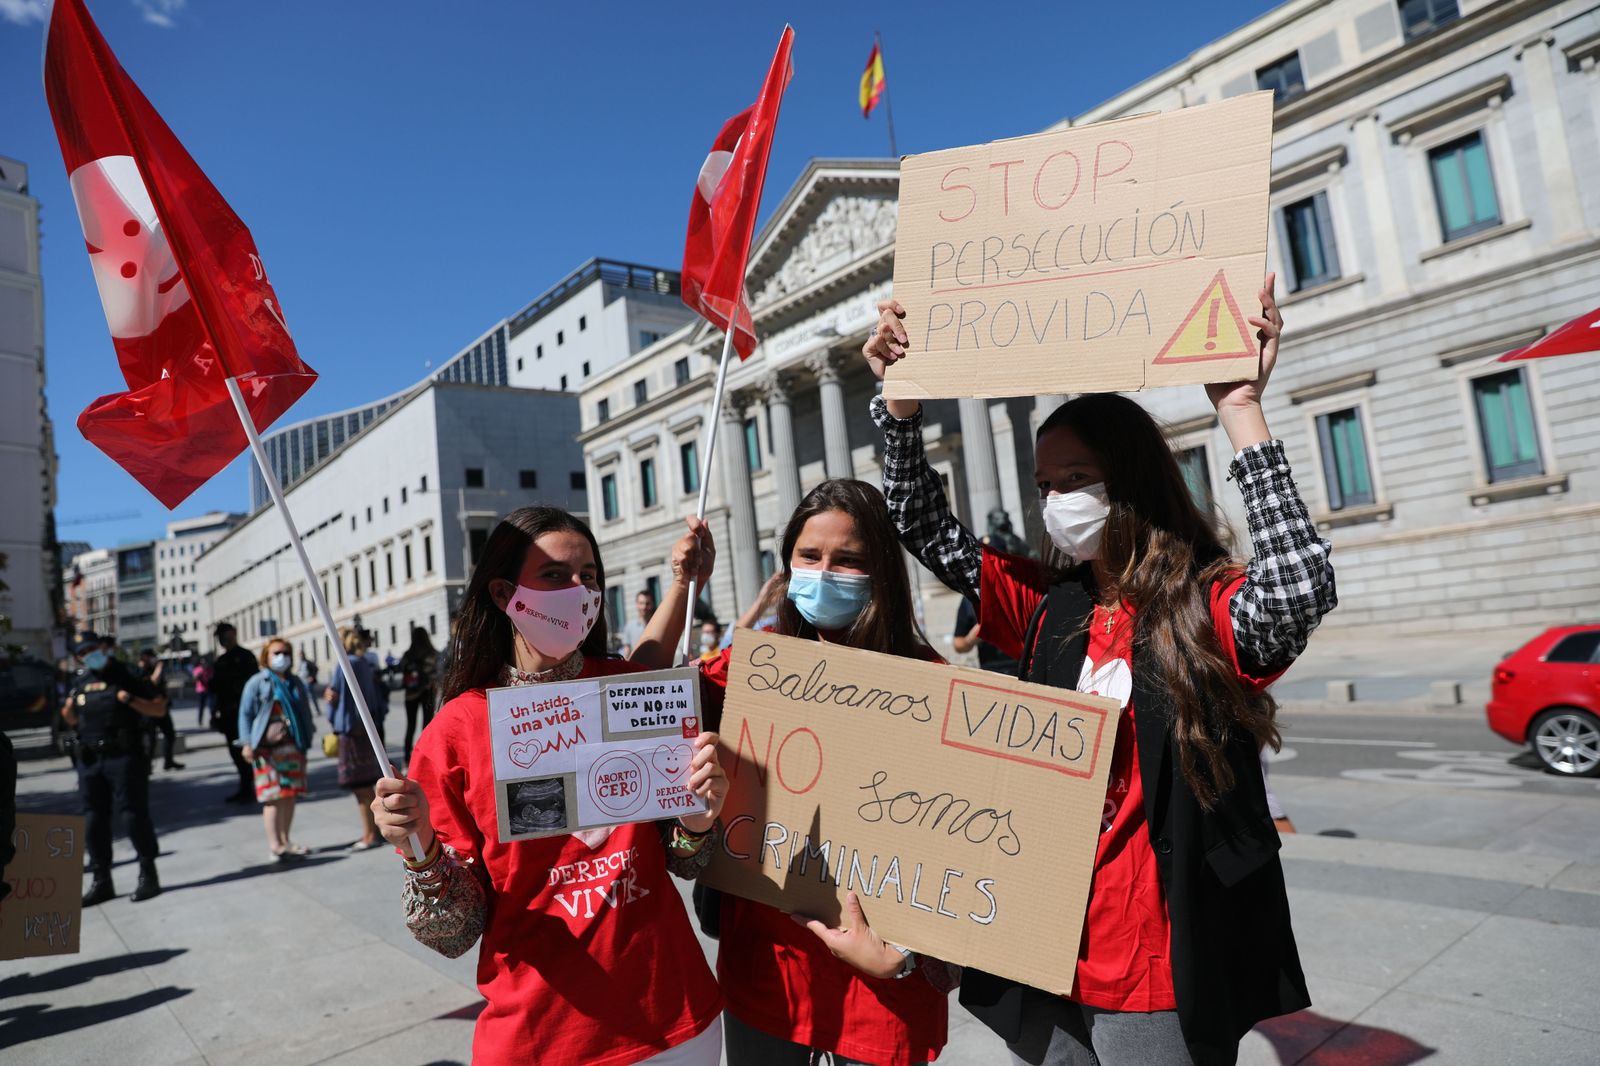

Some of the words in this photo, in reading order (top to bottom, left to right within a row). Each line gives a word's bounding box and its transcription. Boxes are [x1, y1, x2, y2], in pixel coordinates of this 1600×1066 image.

[938, 140, 1135, 222] STOP
[924, 289, 1152, 353] PROVIDA
[609, 686, 666, 698] DEFENDER
[671, 685, 684, 693] LA
[747, 643, 932, 722] Salvamos
[962, 691, 1084, 761] VIDAS
[510, 706, 530, 719] Un
[531, 695, 575, 713] latido,
[644, 700, 663, 712] NO
[676, 700, 687, 709] UN
[511, 719, 543, 736] una
[544, 707, 585, 726] vida.
[734, 717, 823, 795] NO
[597, 769, 638, 785] ABORTO
[599, 781, 638, 798] CERO
[656, 785, 689, 797] DERECH
[658, 794, 695, 809] VIVIR
[722, 814, 997, 925] CRIMINALES
